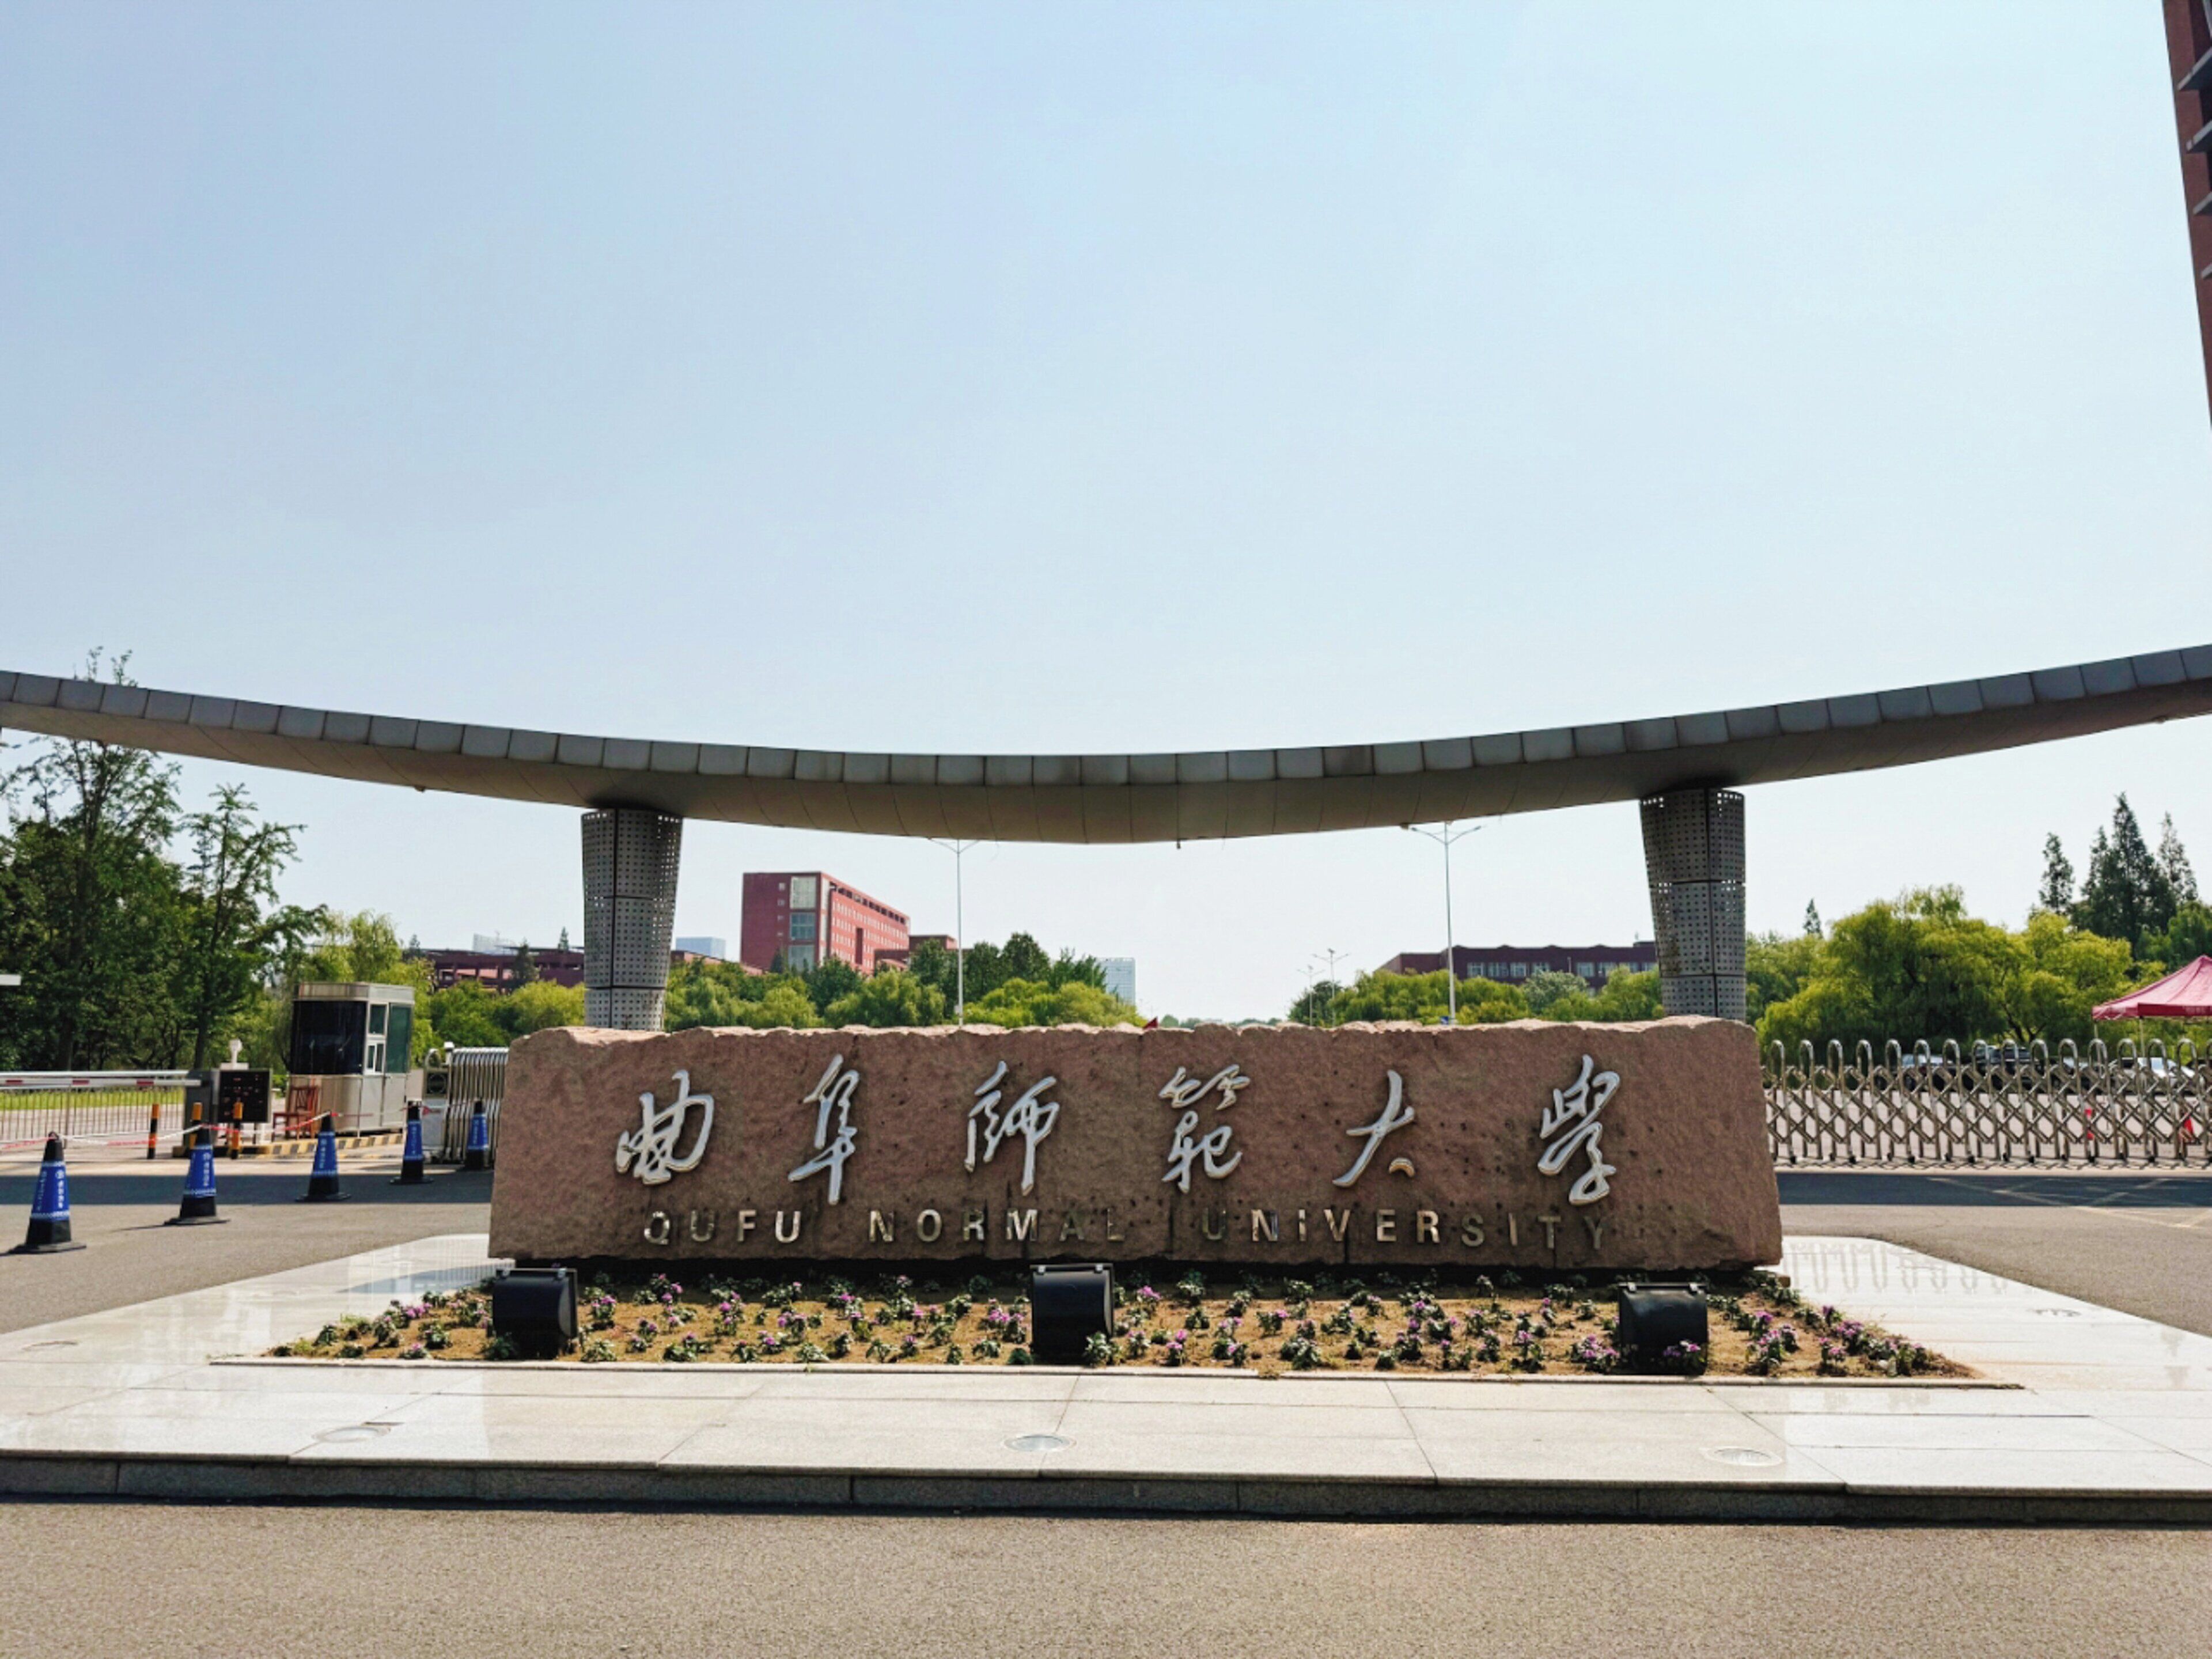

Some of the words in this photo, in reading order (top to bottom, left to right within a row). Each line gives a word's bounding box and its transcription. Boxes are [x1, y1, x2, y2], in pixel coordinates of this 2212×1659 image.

[643, 1210, 801, 1245] QUFU
[868, 1209, 1125, 1243] NORMAL
[1202, 1208, 1603, 1250] UNIVERSITY
